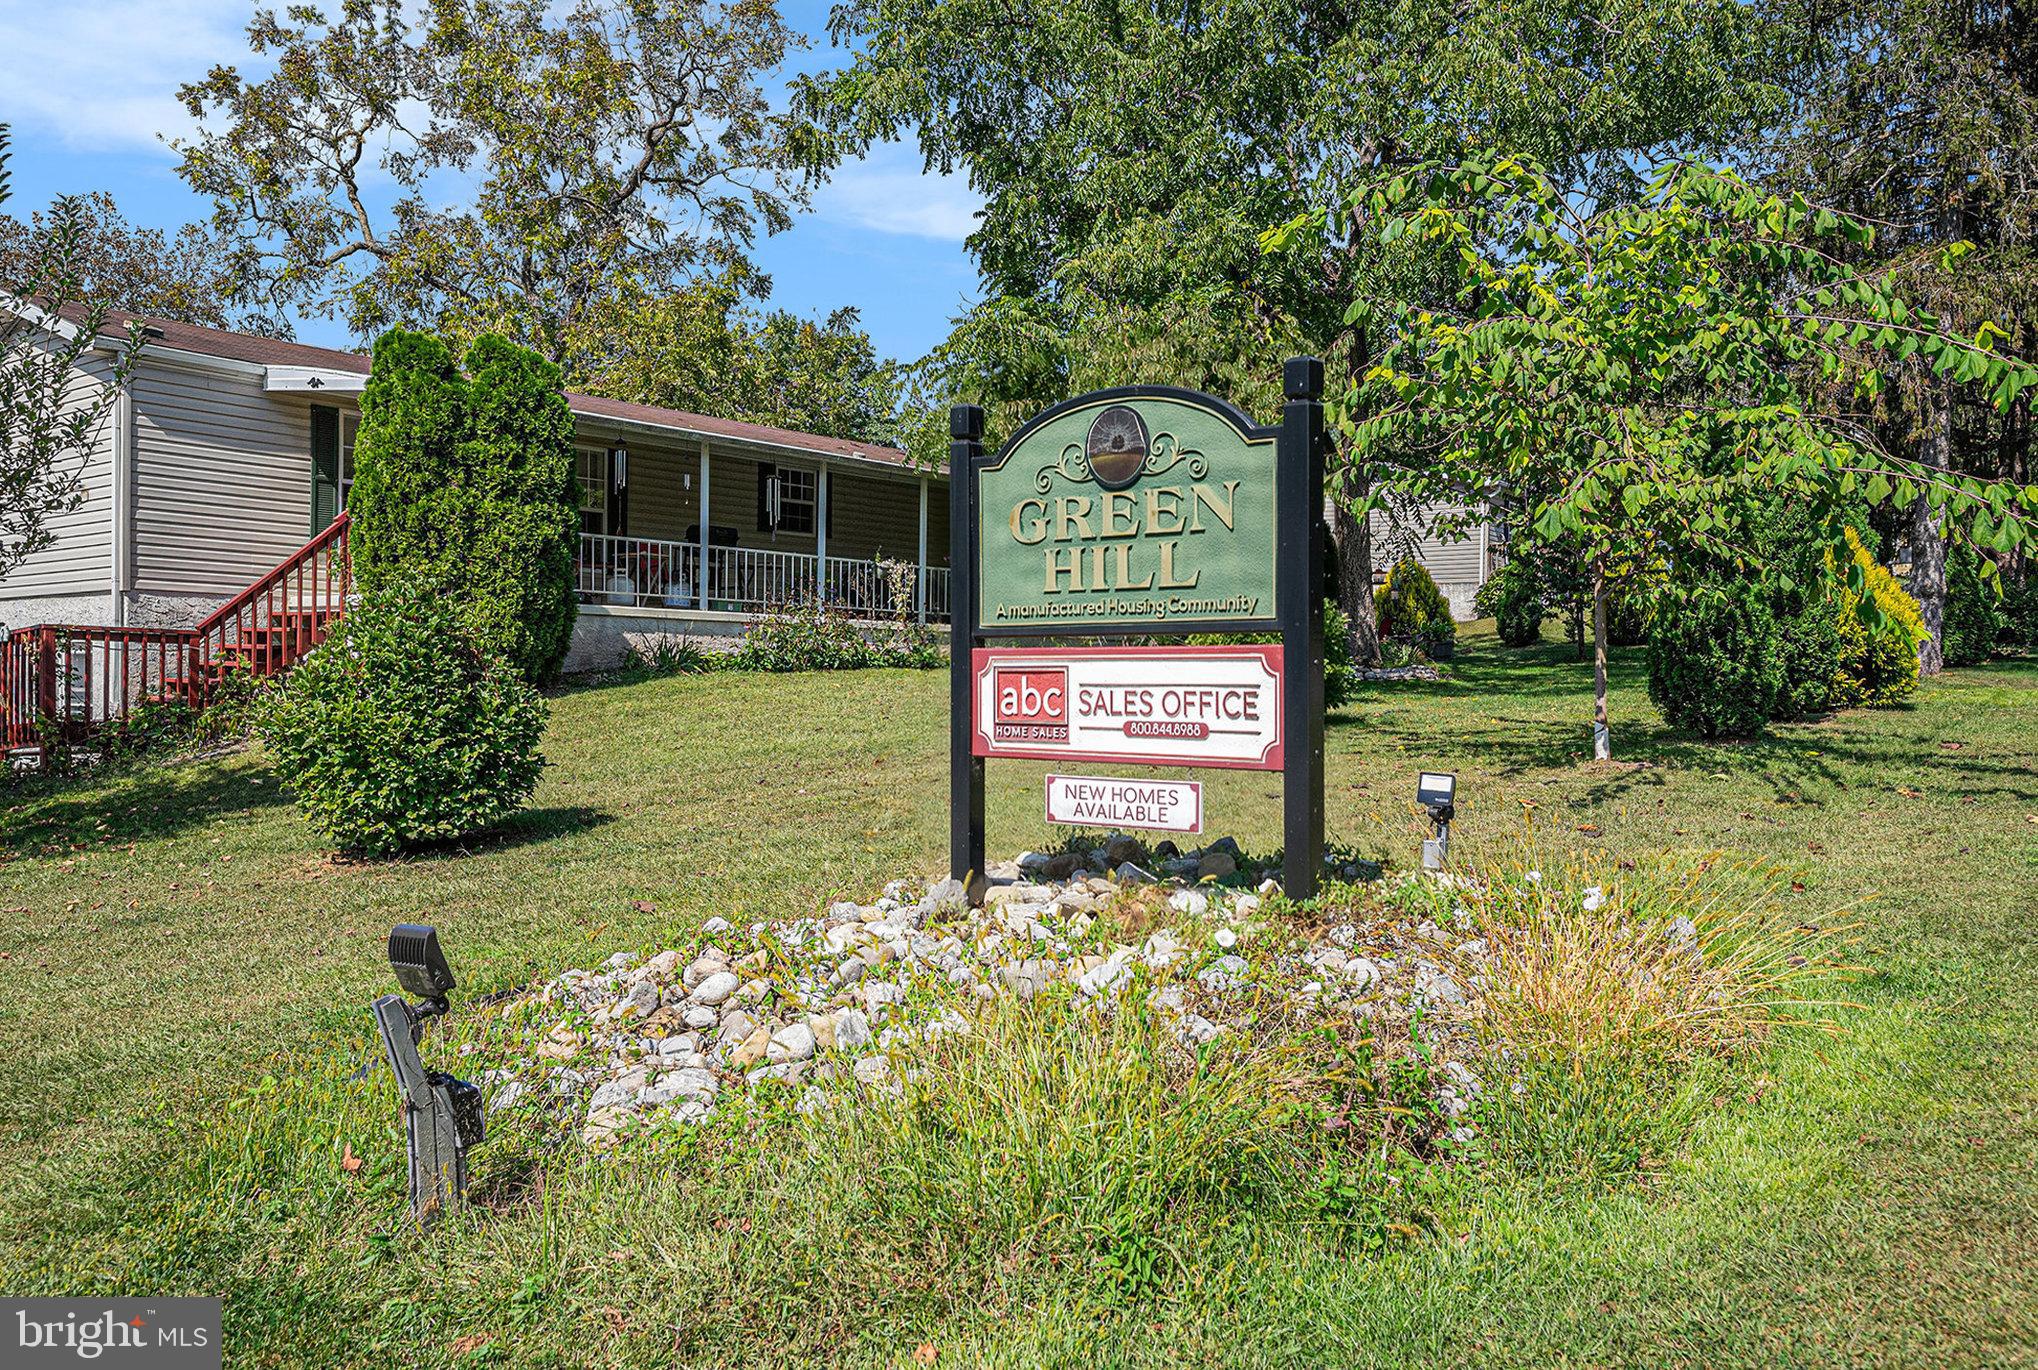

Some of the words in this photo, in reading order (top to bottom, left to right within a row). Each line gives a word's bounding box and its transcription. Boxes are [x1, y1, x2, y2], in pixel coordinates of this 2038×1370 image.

[1008, 480, 1240, 545] GREEN
[1043, 540, 1201, 594] HILL
[996, 602, 1007, 619] A
[1008, 600, 1106, 619] manufactured
[1108, 598, 1166, 619] Housing
[1168, 594, 1258, 616] Community
[1000, 676, 1063, 717] abc
[1079, 689, 1154, 718] SALES
[1162, 690, 1260, 721] OFFICE
[996, 726, 1029, 738] HOME
[1032, 727, 1067, 739] SALES
[1130, 722, 1201, 737] 800.844.8988
[1064, 784, 1107, 801] NEW
[1111, 787, 1179, 806] HOMES
[1073, 802, 1169, 824] AVAILABLE
